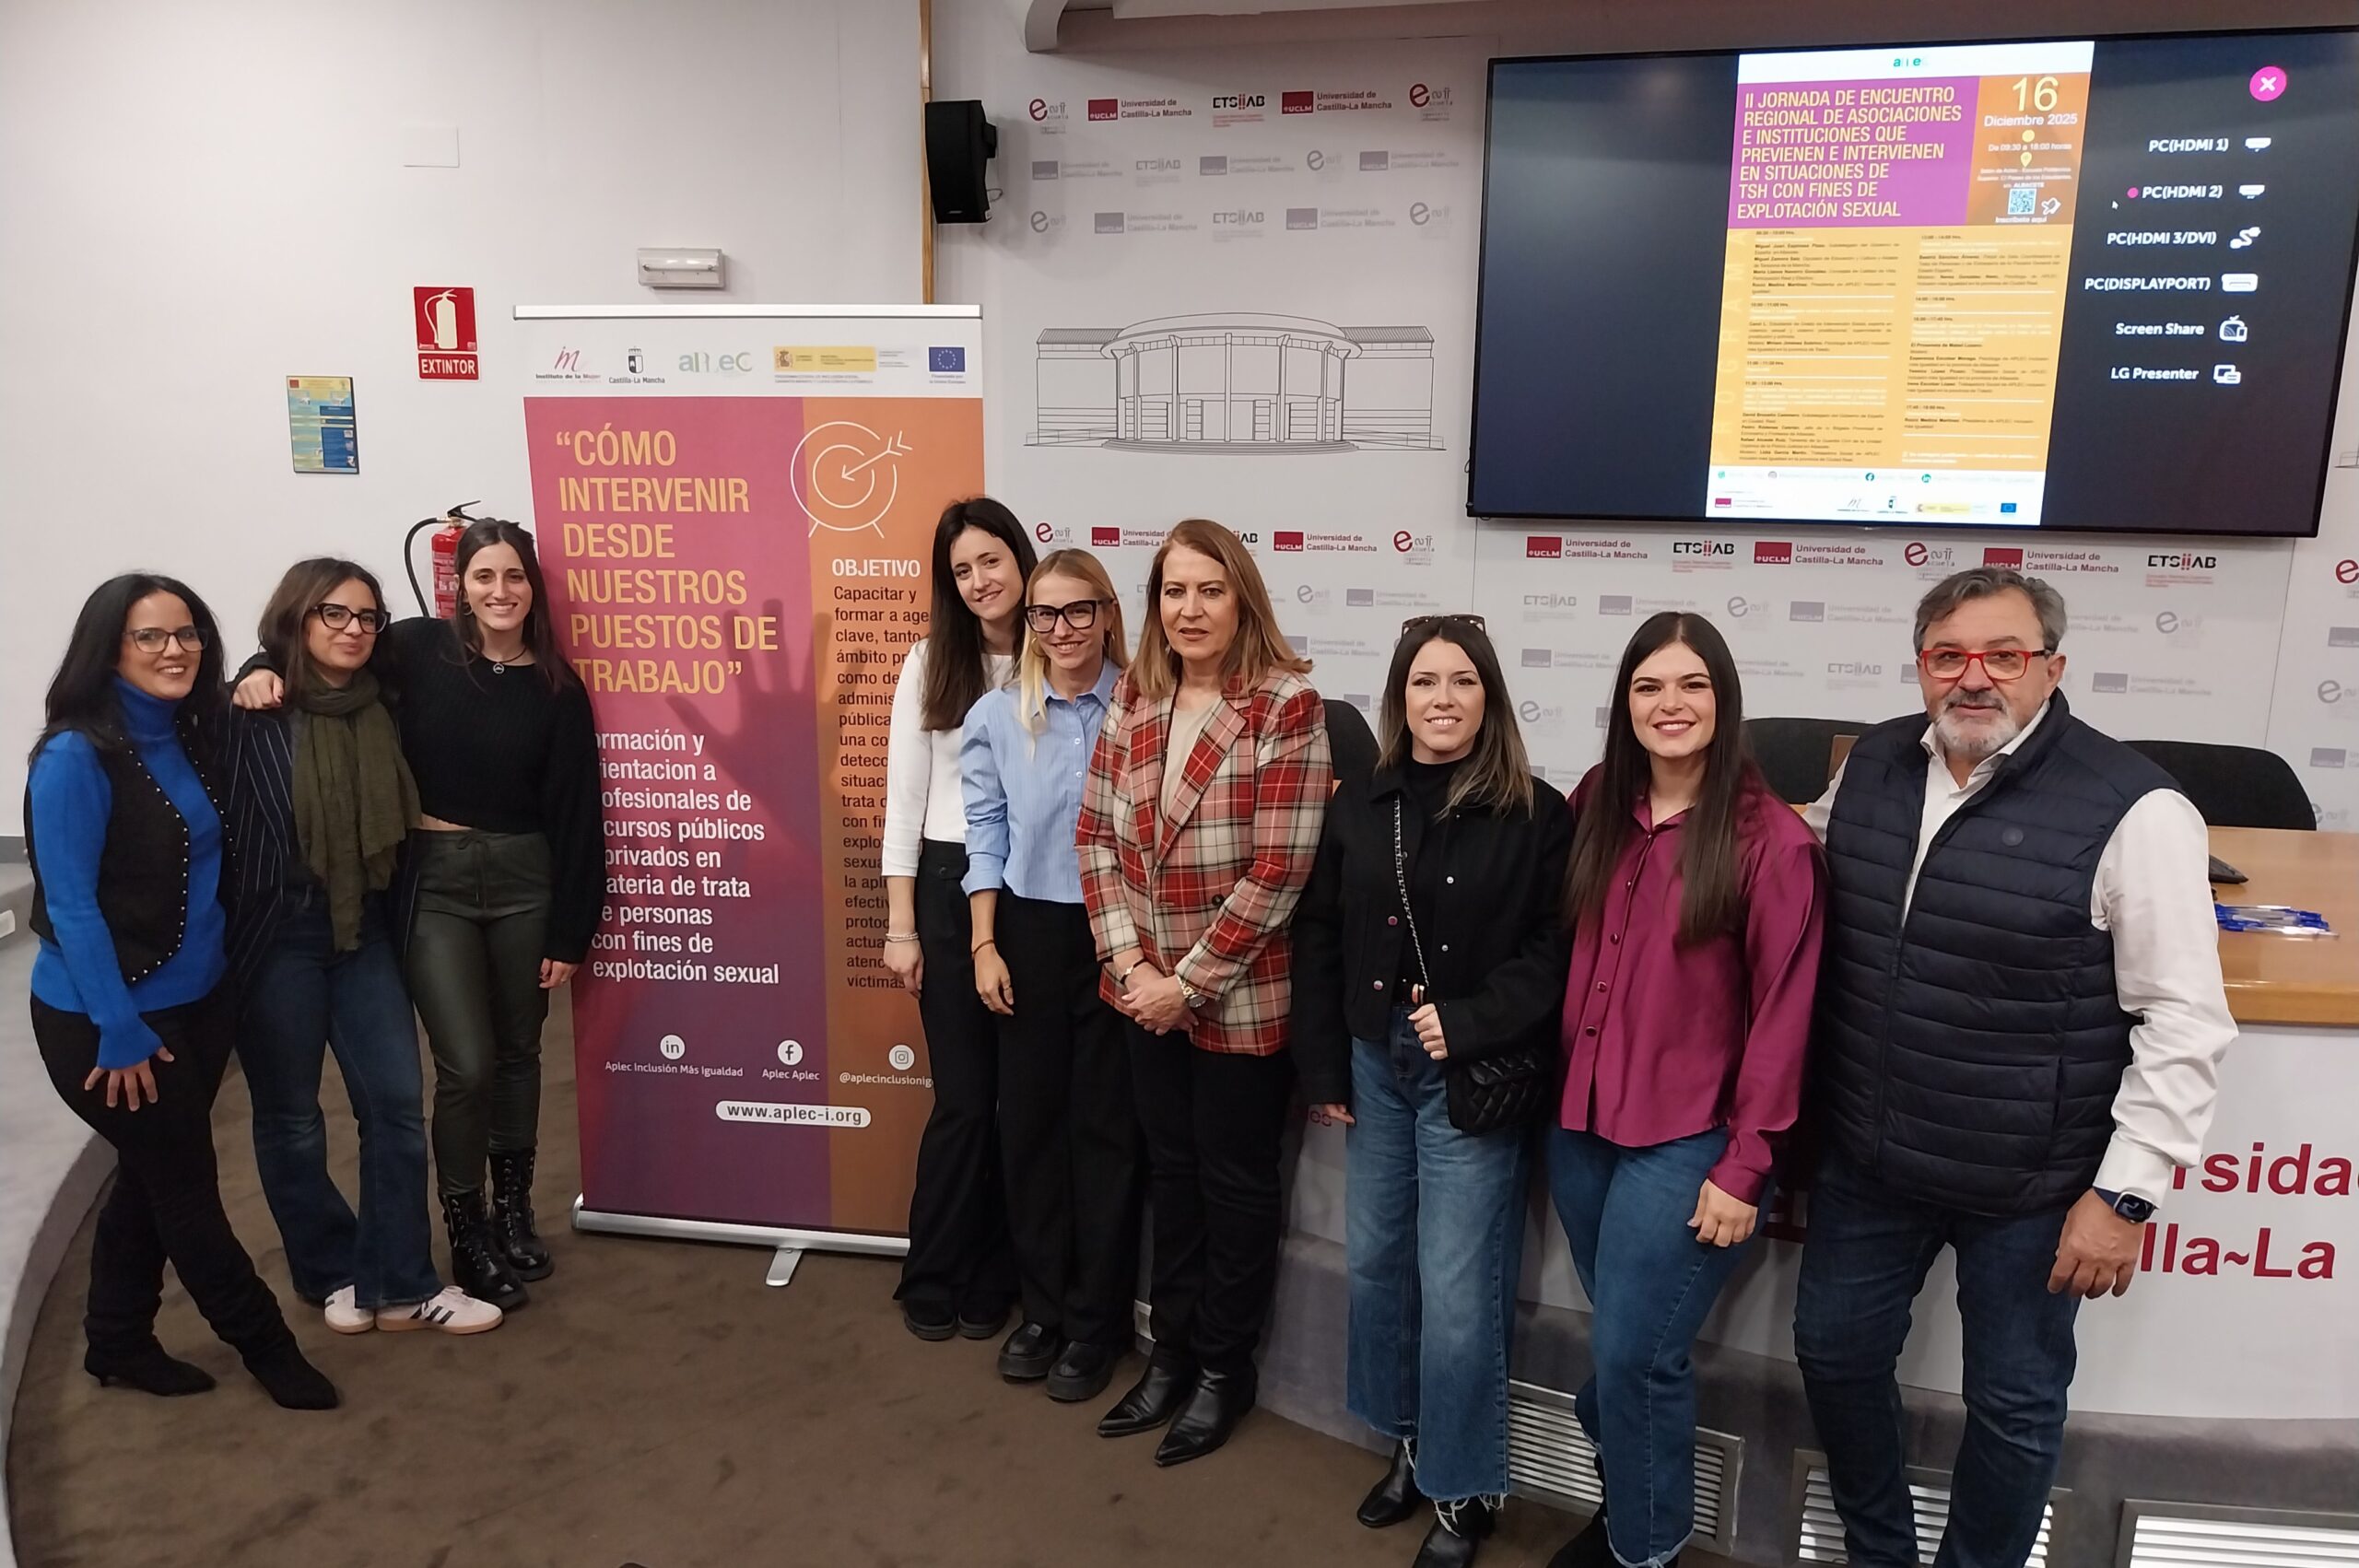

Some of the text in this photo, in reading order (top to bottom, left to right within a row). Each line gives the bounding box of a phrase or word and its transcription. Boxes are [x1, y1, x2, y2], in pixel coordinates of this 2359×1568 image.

[1317, 90, 1377, 100] Universidad de
[1745, 87, 1954, 109] II JORNADA DE ENCUENTRO
[2013, 76, 2059, 111] 16
[1121, 99, 1165, 108] Universidad
[1317, 103, 1358, 111] Castilla-La
[1121, 110, 1160, 118] Castilla-La
[1743, 105, 1962, 126] REGIONAL DE ASOCIACIONES
[1984, 113, 2078, 127] Diciembre 2025
[1743, 125, 1907, 145] E INSTITUCIONES QUE
[2149, 138, 2229, 153] PC(HDMI 1)
[1741, 144, 1944, 163] PREVIENEN E INTERVIENEN
[1740, 163, 1890, 181] EN SITUACIONES DE
[1739, 181, 1878, 199] TSH CON FINES DE
[2142, 185, 2224, 199] PC(HDMI 2)
[1737, 199, 1901, 218] EXPLOTACIÓN SEXUAL
[2107, 232, 2217, 246] PC(HDMI 3/DVI)
[2085, 277, 2212, 291] PC(DISPLAYPORT)
[2116, 323, 2204, 335] Screen Share
[421, 358, 475, 375] EXTINTOR
[2111, 368, 2199, 380] LG Presenter
[557, 422, 676, 466] “CÓMO
[559, 477, 750, 512] INTERVENIR
[1123, 529, 1165, 537] Universidad
[1307, 533, 1351, 542] Universidad
[563, 523, 675, 558] DESDE
[1566, 539, 1618, 548] Universidad
[1566, 550, 1648, 559] Castilla-La Mancha
[1796, 544, 1850, 554] Universidad
[2027, 551, 2086, 560] Universidad
[832, 558, 921, 578] OBJETIVO
[1795, 556, 1884, 566] Castilla-La Mancha
[2026, 562, 2119, 573] Castilla-La Mancha
[567, 568, 747, 604] NUESTROS
[834, 586, 917, 603] Capacitar y
[835, 607, 930, 625] formar a age
[570, 614, 778, 650] PUESTOS DE
[836, 628, 921, 645] clave, tanto
[837, 649, 887, 663] ámbito
[838, 673, 877, 684] como
[839, 692, 894, 706] adminis
[839, 711, 891, 728] pública
[595, 729, 704, 755] rmación y
[840, 735, 866, 746] una
[840, 753, 888, 767] detecc
[600, 757, 716, 780] ientacion a
[841, 774, 886, 788] situac
[602, 788, 751, 811] ofesionales de
[841, 794, 874, 808] trata
[842, 816, 867, 827] con
[604, 817, 765, 842] cursos públicos
[696, 851, 721, 868] en
[844, 857, 882, 869] sexua
[606, 874, 751, 897] ateria de trata
[845, 875, 856, 888] la
[602, 905, 712, 926] e personas
[846, 917, 889, 930] protoc
[592, 930, 713, 953] con fines de
[847, 937, 885, 948] actua
[847, 955, 886, 968] atenc
[593, 959, 779, 984] explotación sexual
[847, 976, 906, 989] víctimas
[605, 1061, 744, 1078] Aplec Inclusión Más Igualdad
[761, 1069, 820, 1082] Aplec Aplec
[839, 1072, 933, 1088] @aplecinclusionig
[727, 1105, 862, 1126] www.aplec-i.org
[2141, 1223, 2336, 1280] lla~La
